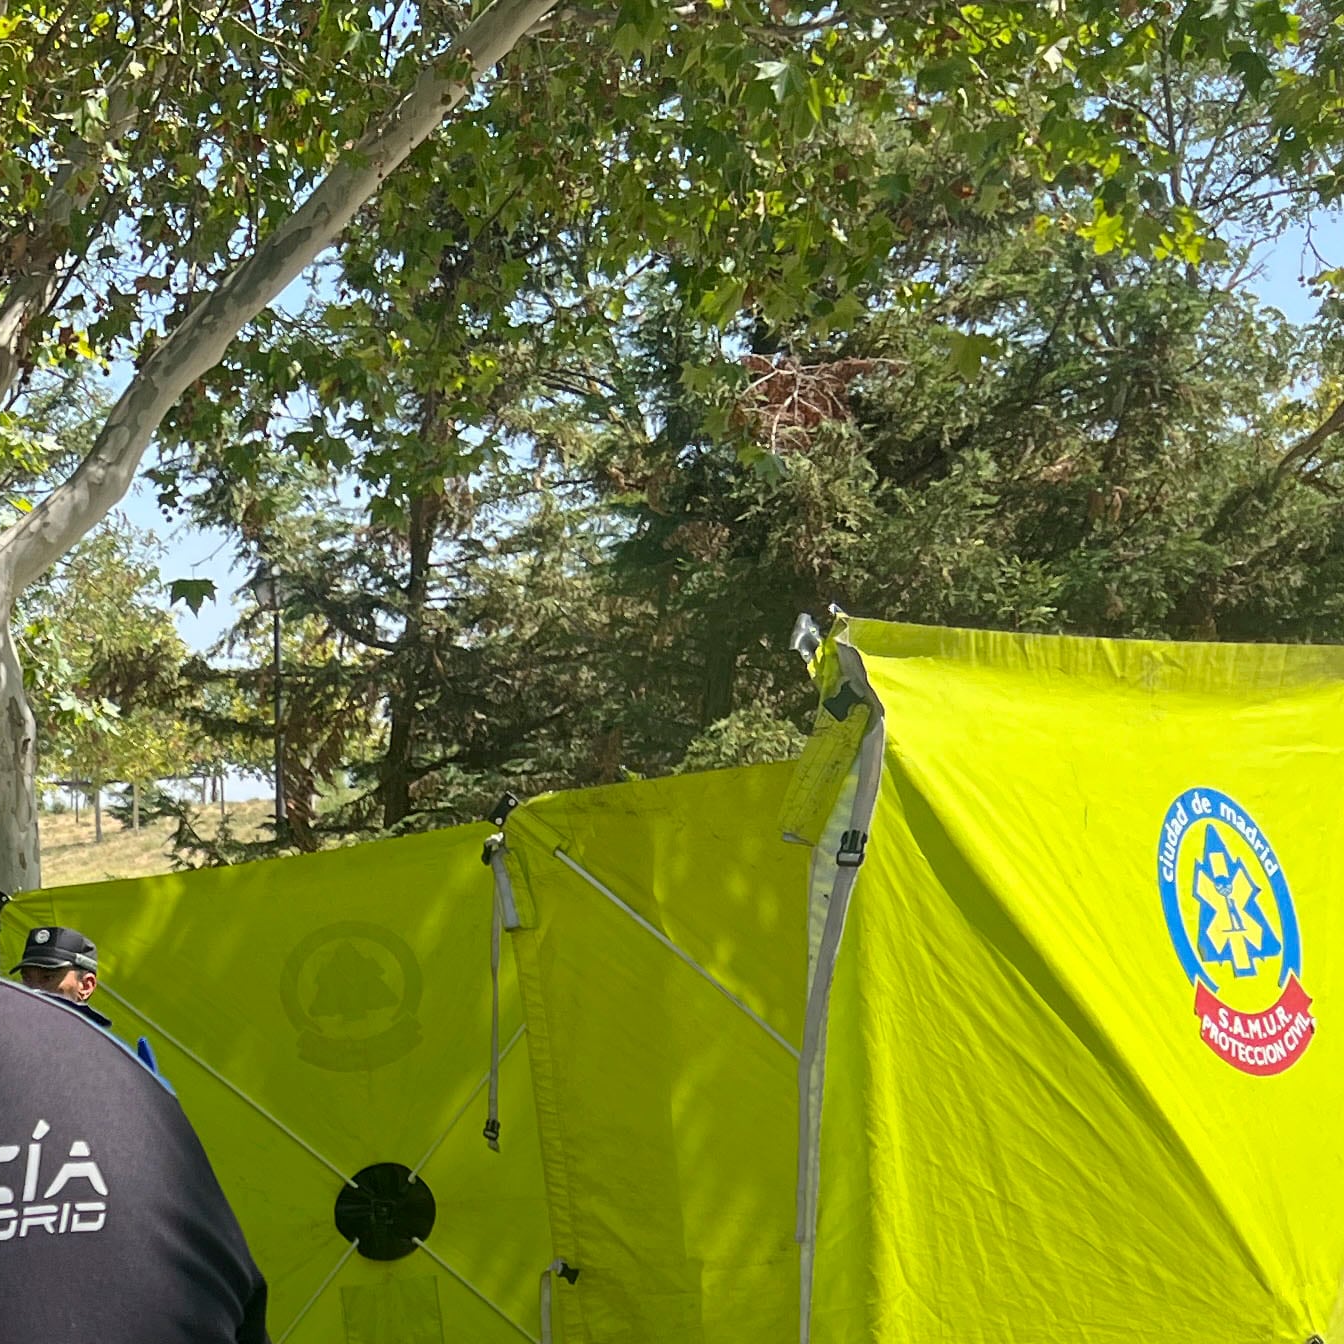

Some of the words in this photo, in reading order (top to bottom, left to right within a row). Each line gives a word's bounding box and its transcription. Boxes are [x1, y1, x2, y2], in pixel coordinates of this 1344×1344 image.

[1159, 801, 1189, 883] ciudad
[1191, 791, 1213, 815] de
[1220, 802, 1279, 877] madrid
[1202, 1013, 1288, 1066] PROTECCION
[1283, 1011, 1311, 1052] CIVIL
[1218, 1004, 1293, 1040] S.A.M.U.R.
